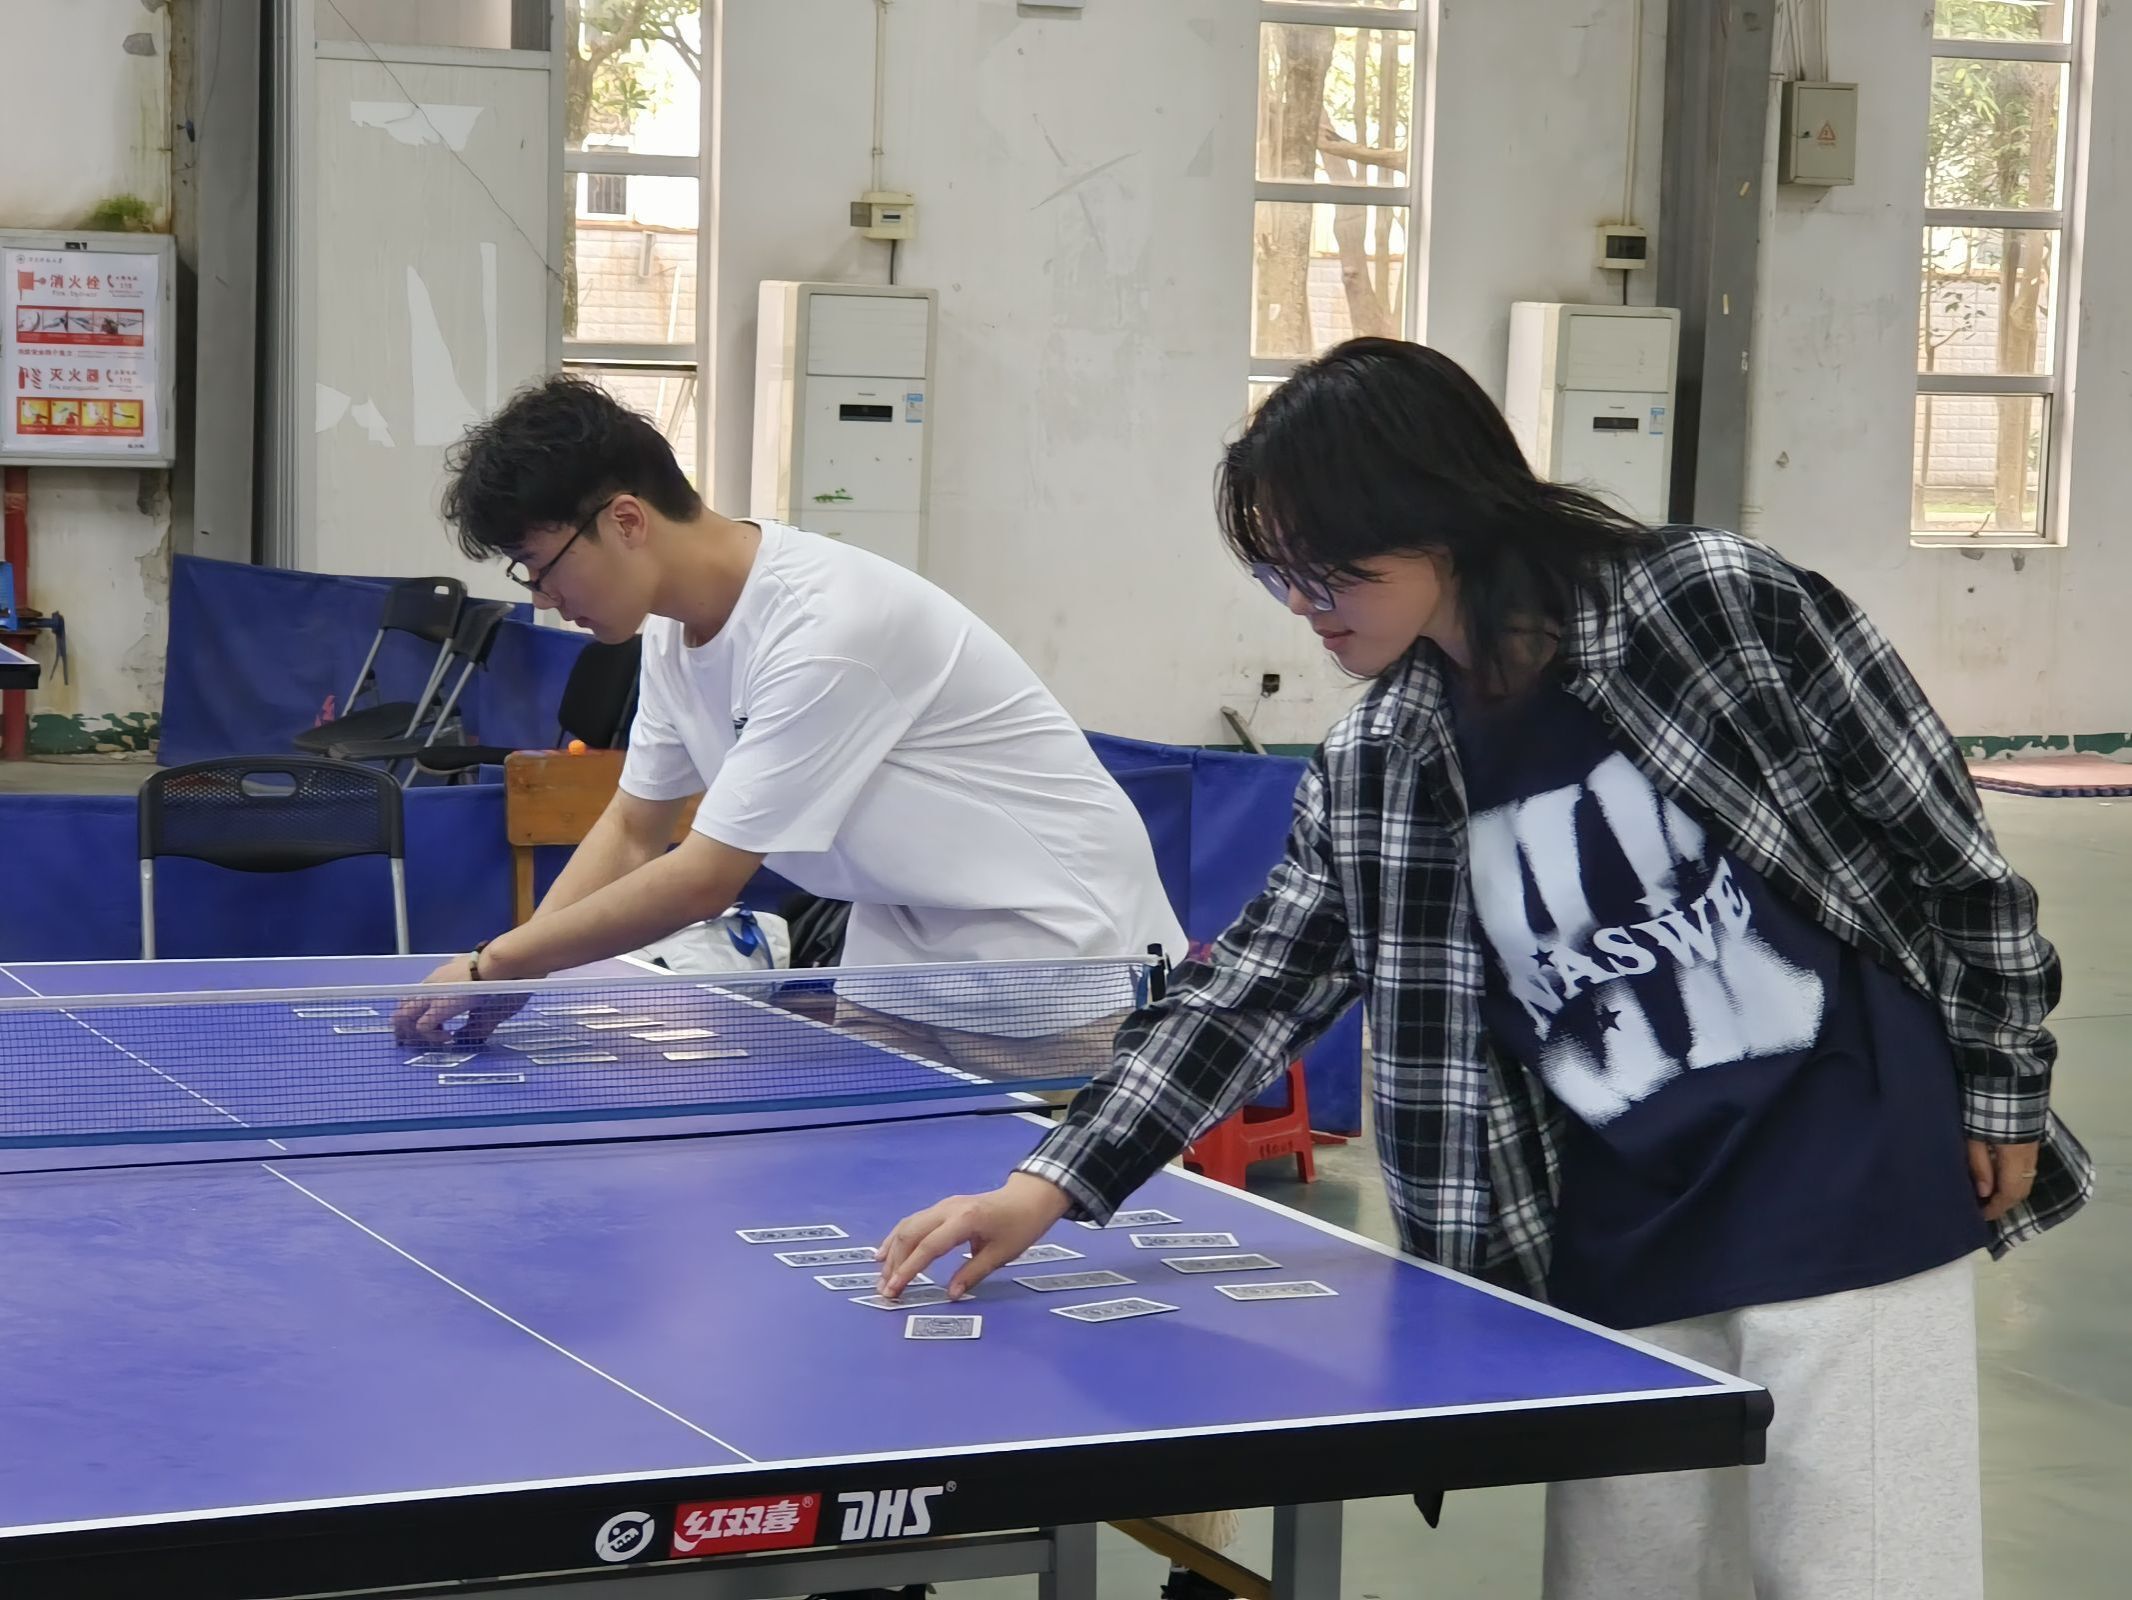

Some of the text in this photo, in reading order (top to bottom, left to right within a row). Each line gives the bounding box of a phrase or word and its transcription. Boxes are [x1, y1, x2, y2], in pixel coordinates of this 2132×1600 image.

[50, 274, 100, 290] 消火栓
[50, 368, 99, 383] 灭火器
[676, 1500, 801, 1550] 红双喜
[837, 1485, 944, 1541] DHS
